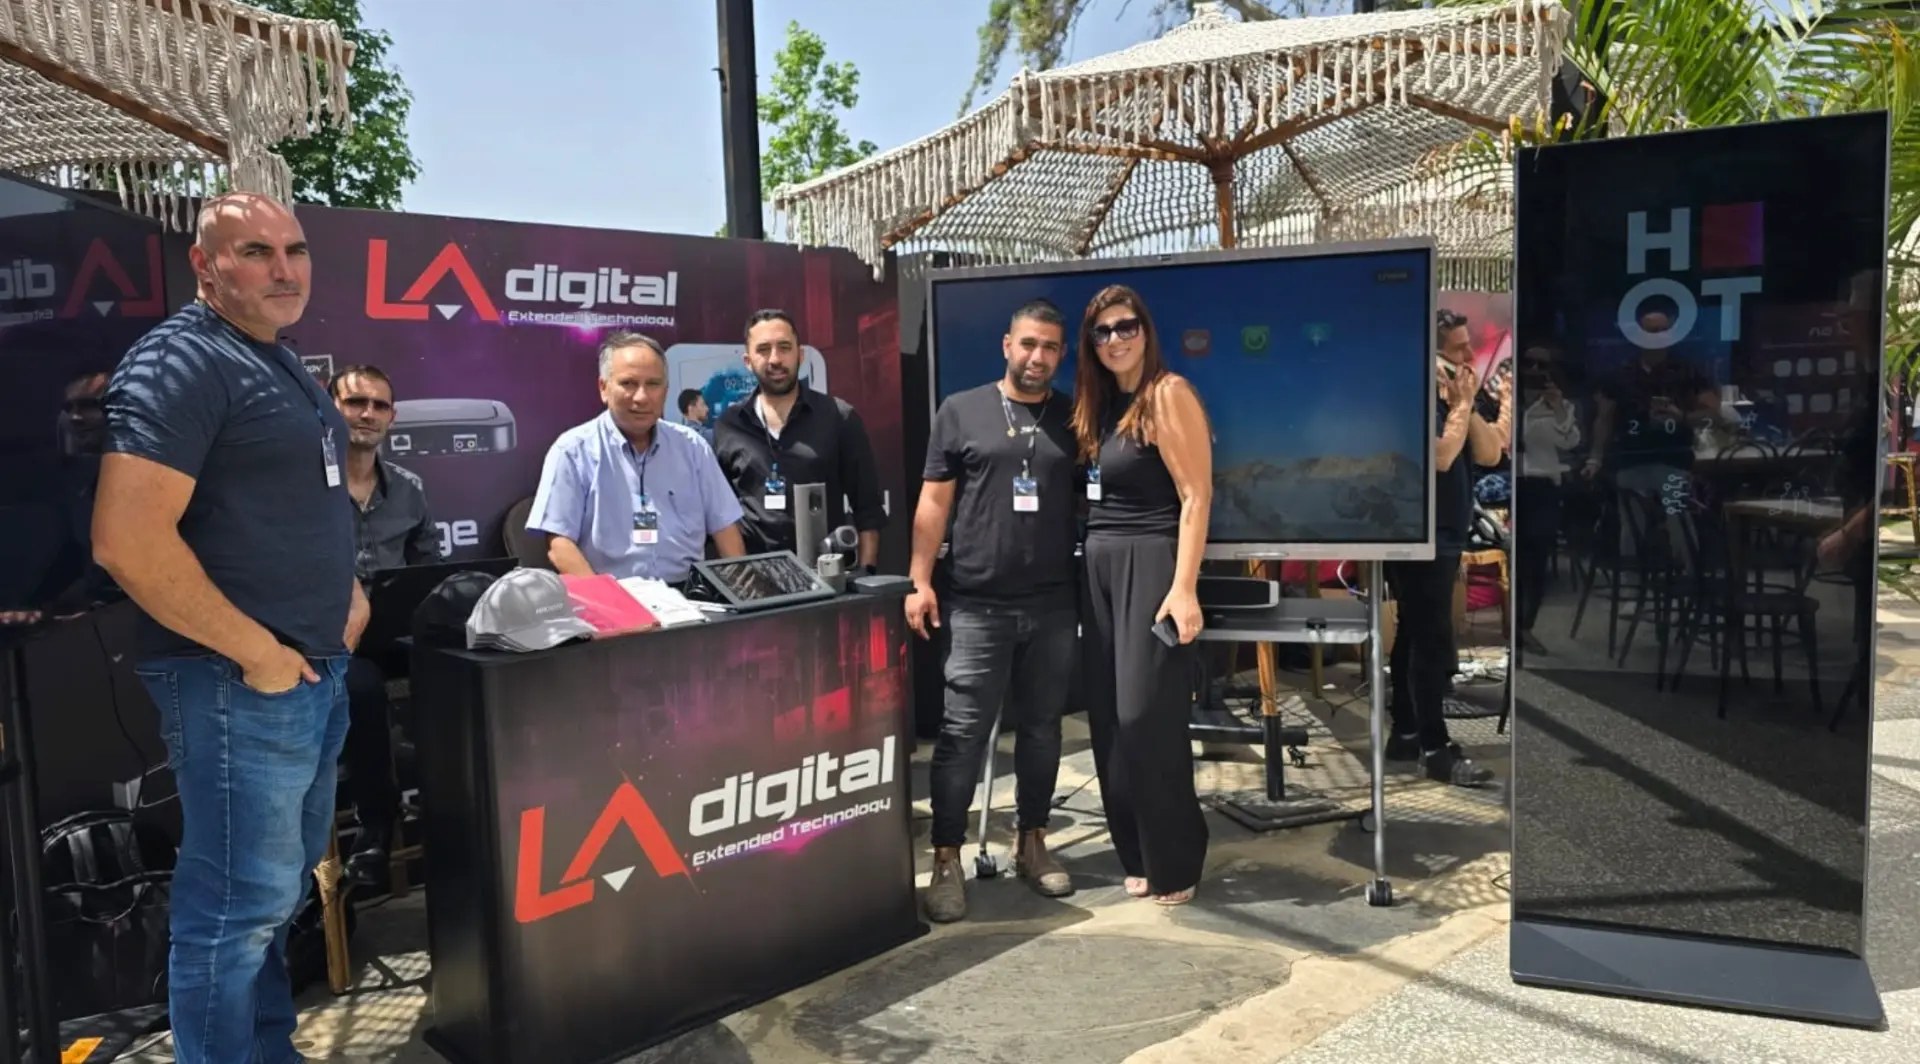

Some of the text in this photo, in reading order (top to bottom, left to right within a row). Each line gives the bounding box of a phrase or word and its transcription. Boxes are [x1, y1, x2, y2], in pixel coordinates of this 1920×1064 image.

[366, 239, 678, 320] LA digital
[589, 312, 675, 326] Technology
[515, 735, 895, 923] LA digital
[692, 797, 891, 866] Extended Technology
